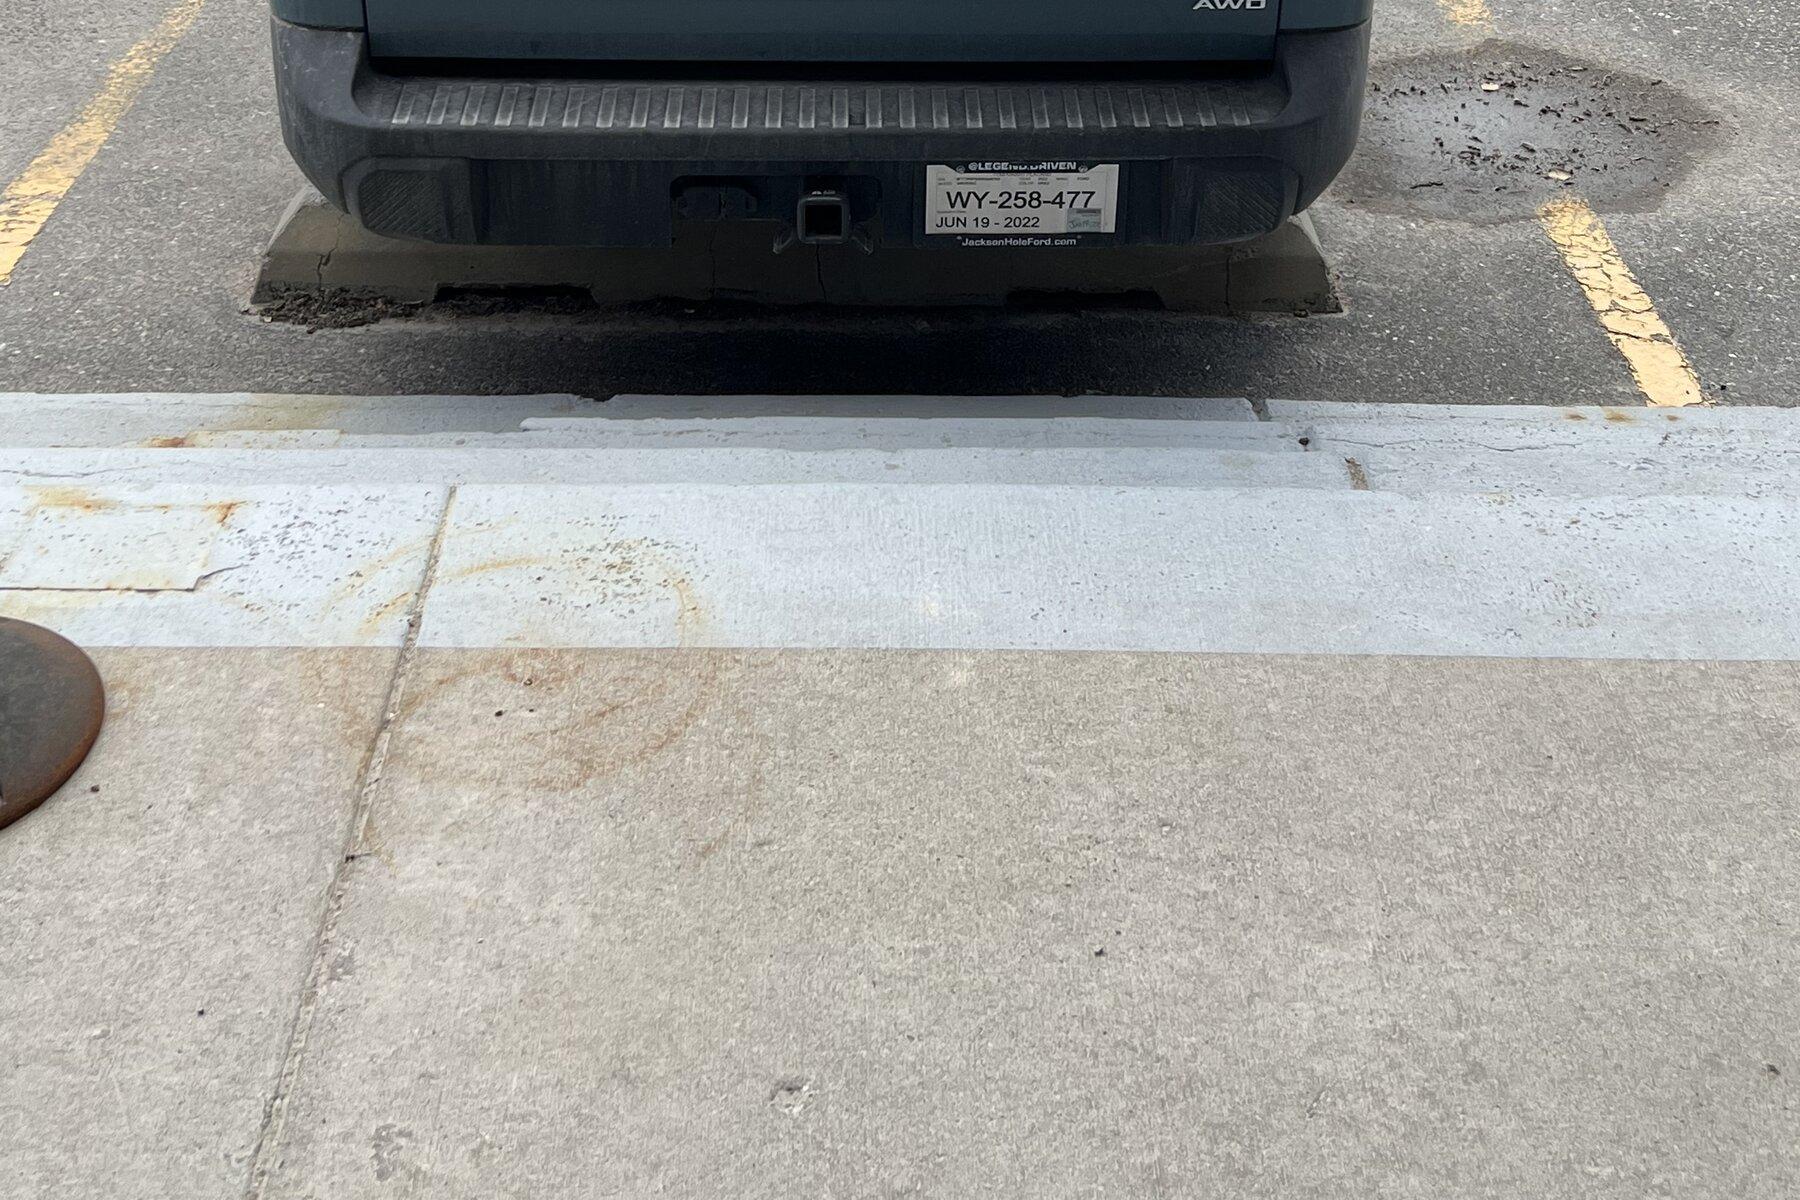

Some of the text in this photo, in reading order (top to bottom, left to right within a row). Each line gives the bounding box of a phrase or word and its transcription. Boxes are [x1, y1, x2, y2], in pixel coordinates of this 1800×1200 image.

[946, 190, 1096, 209] WY-258-477
[935, 216, 967, 229] JUN
[972, 216, 989, 229] 19
[1003, 216, 1040, 229] 2022
[961, 237, 1077, 247] JacksonHoleFord.com
